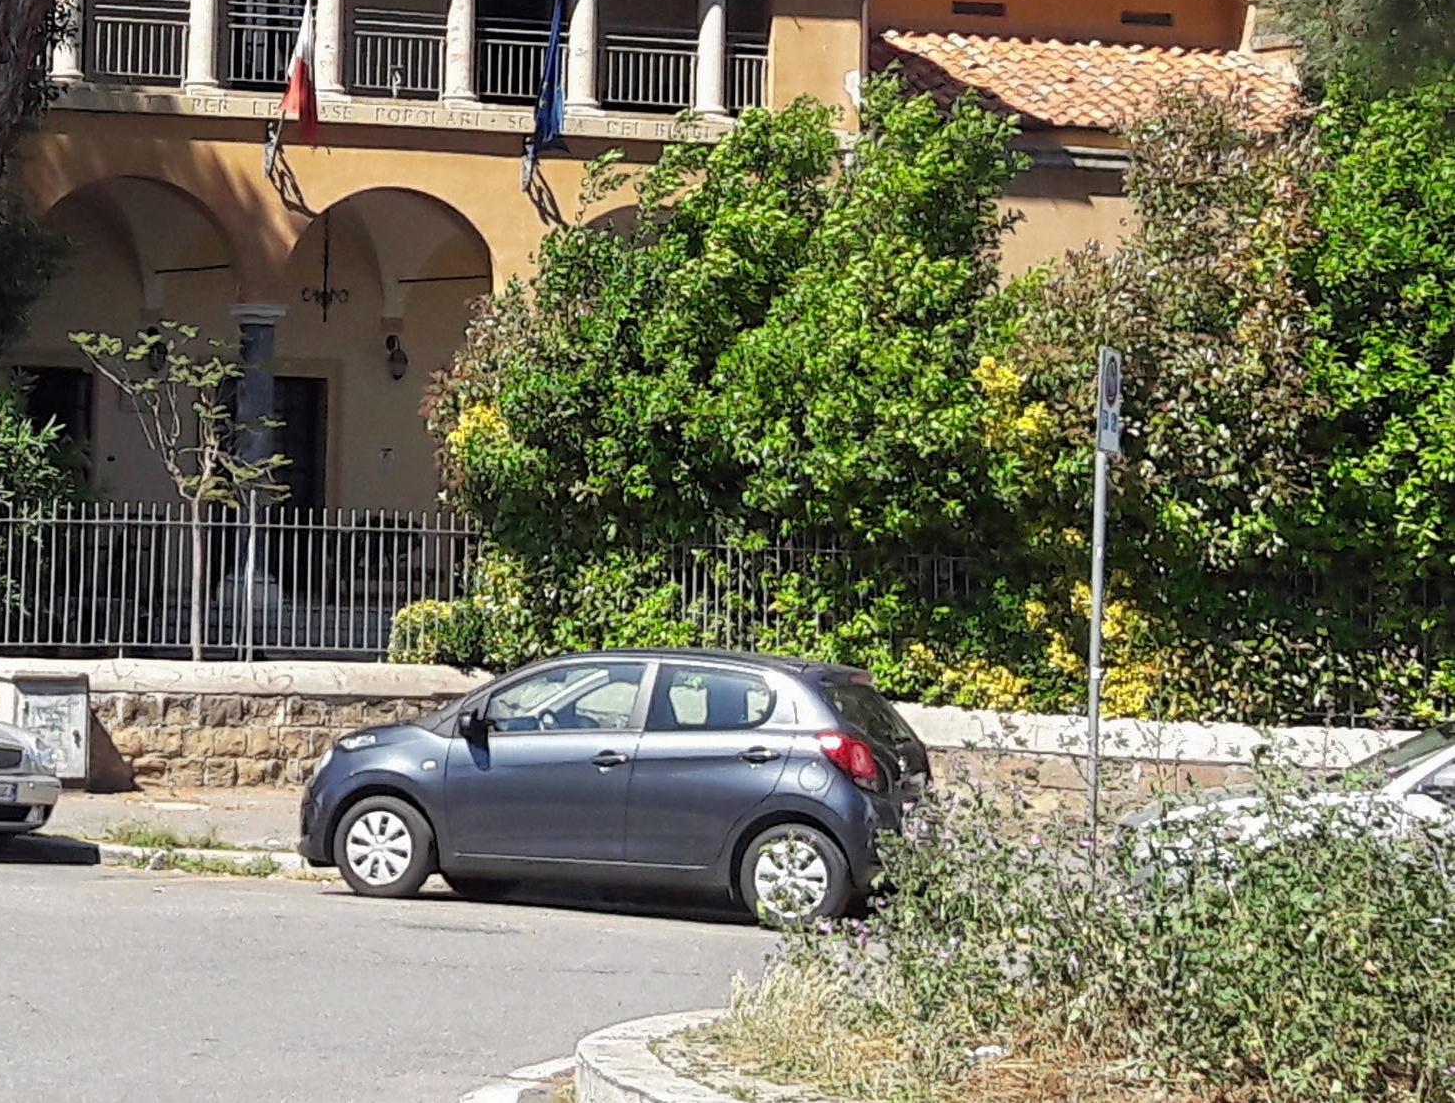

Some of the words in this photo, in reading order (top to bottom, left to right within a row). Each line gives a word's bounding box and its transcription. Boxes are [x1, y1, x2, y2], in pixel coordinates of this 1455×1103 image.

[191, 97, 230, 114] PER
[252, 100, 280, 117] LE
[375, 106, 480, 127] POPOLARI
